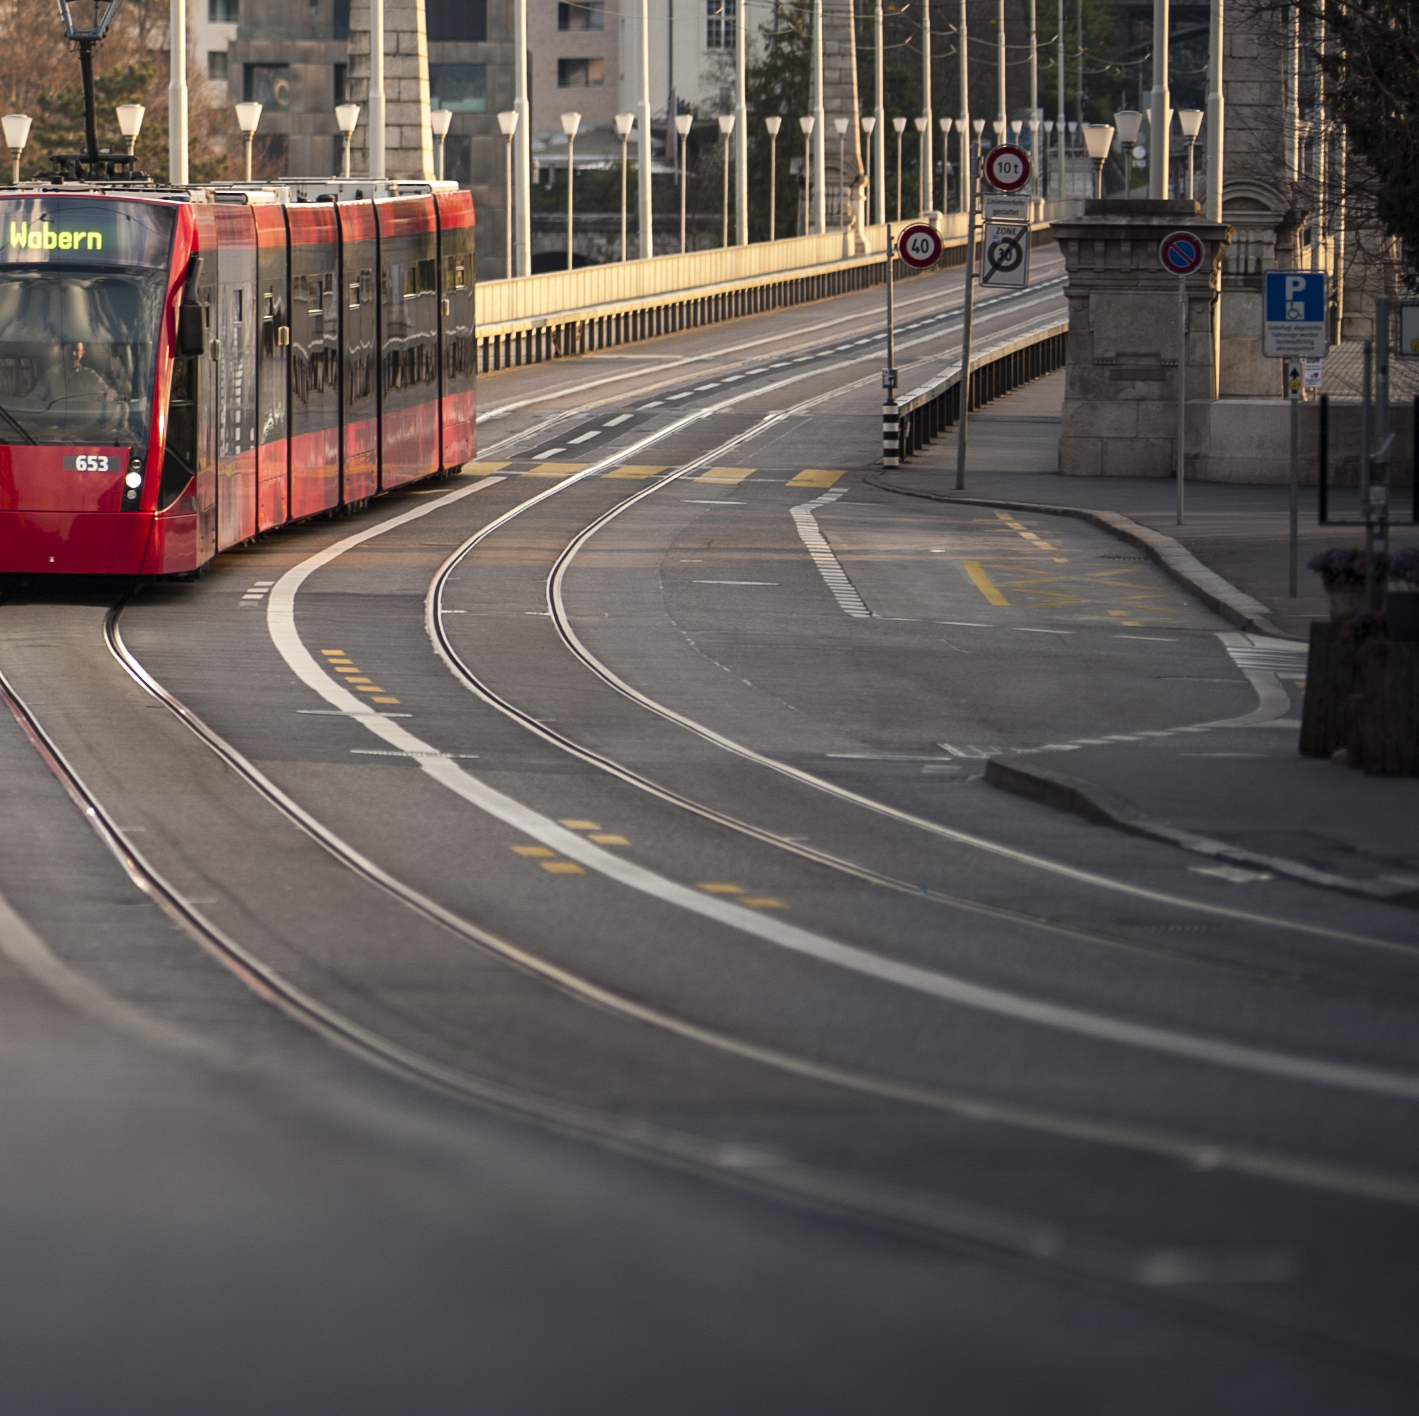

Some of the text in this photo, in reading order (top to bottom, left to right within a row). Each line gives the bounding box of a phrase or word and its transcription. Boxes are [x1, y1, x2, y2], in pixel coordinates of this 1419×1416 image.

[998, 162, 1019, 174] 10 t
[10, 221, 103, 250] Wabern
[996, 227, 1017, 235] ZONE
[911, 239, 929, 254] 40
[998, 248, 1013, 261] 30
[1285, 275, 1307, 300] P
[76, 455, 109, 472] 653
